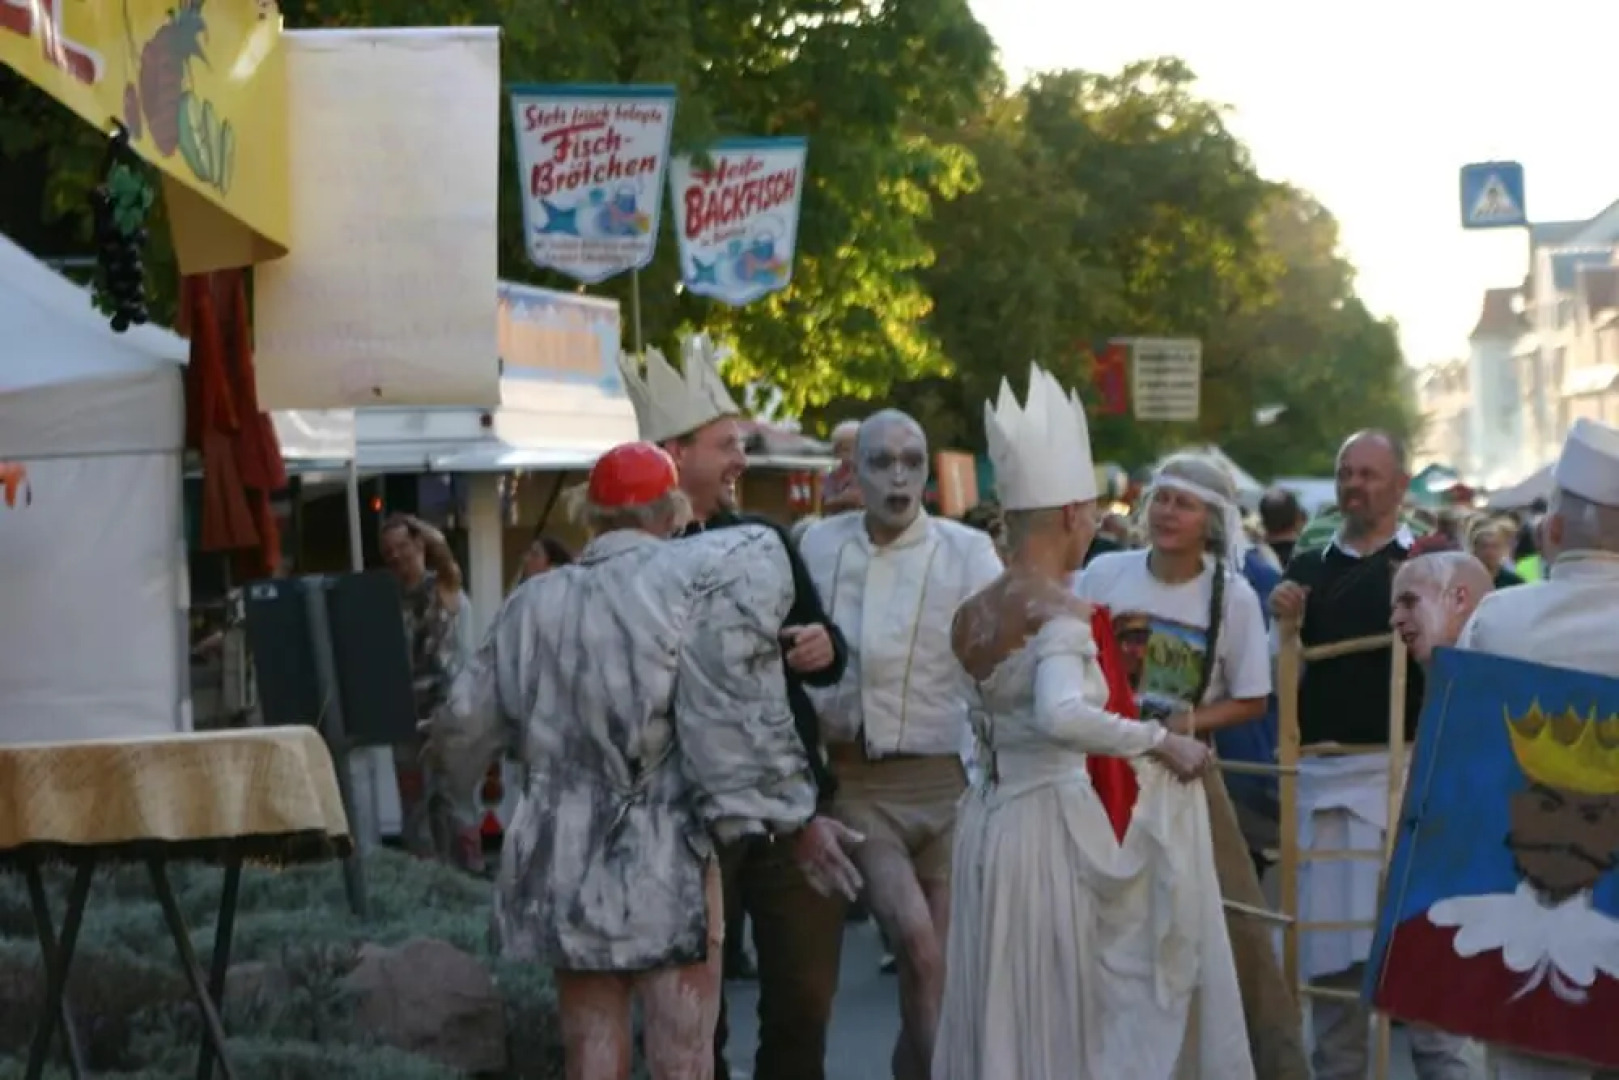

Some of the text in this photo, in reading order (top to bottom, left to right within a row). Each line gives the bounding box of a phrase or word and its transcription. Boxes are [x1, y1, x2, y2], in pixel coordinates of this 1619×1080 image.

[525, 103, 566, 131] Stets
[541, 121, 632, 163] Fisch-
[531, 155, 656, 197] Brötchen
[685, 167, 797, 240] BACKFISCH
